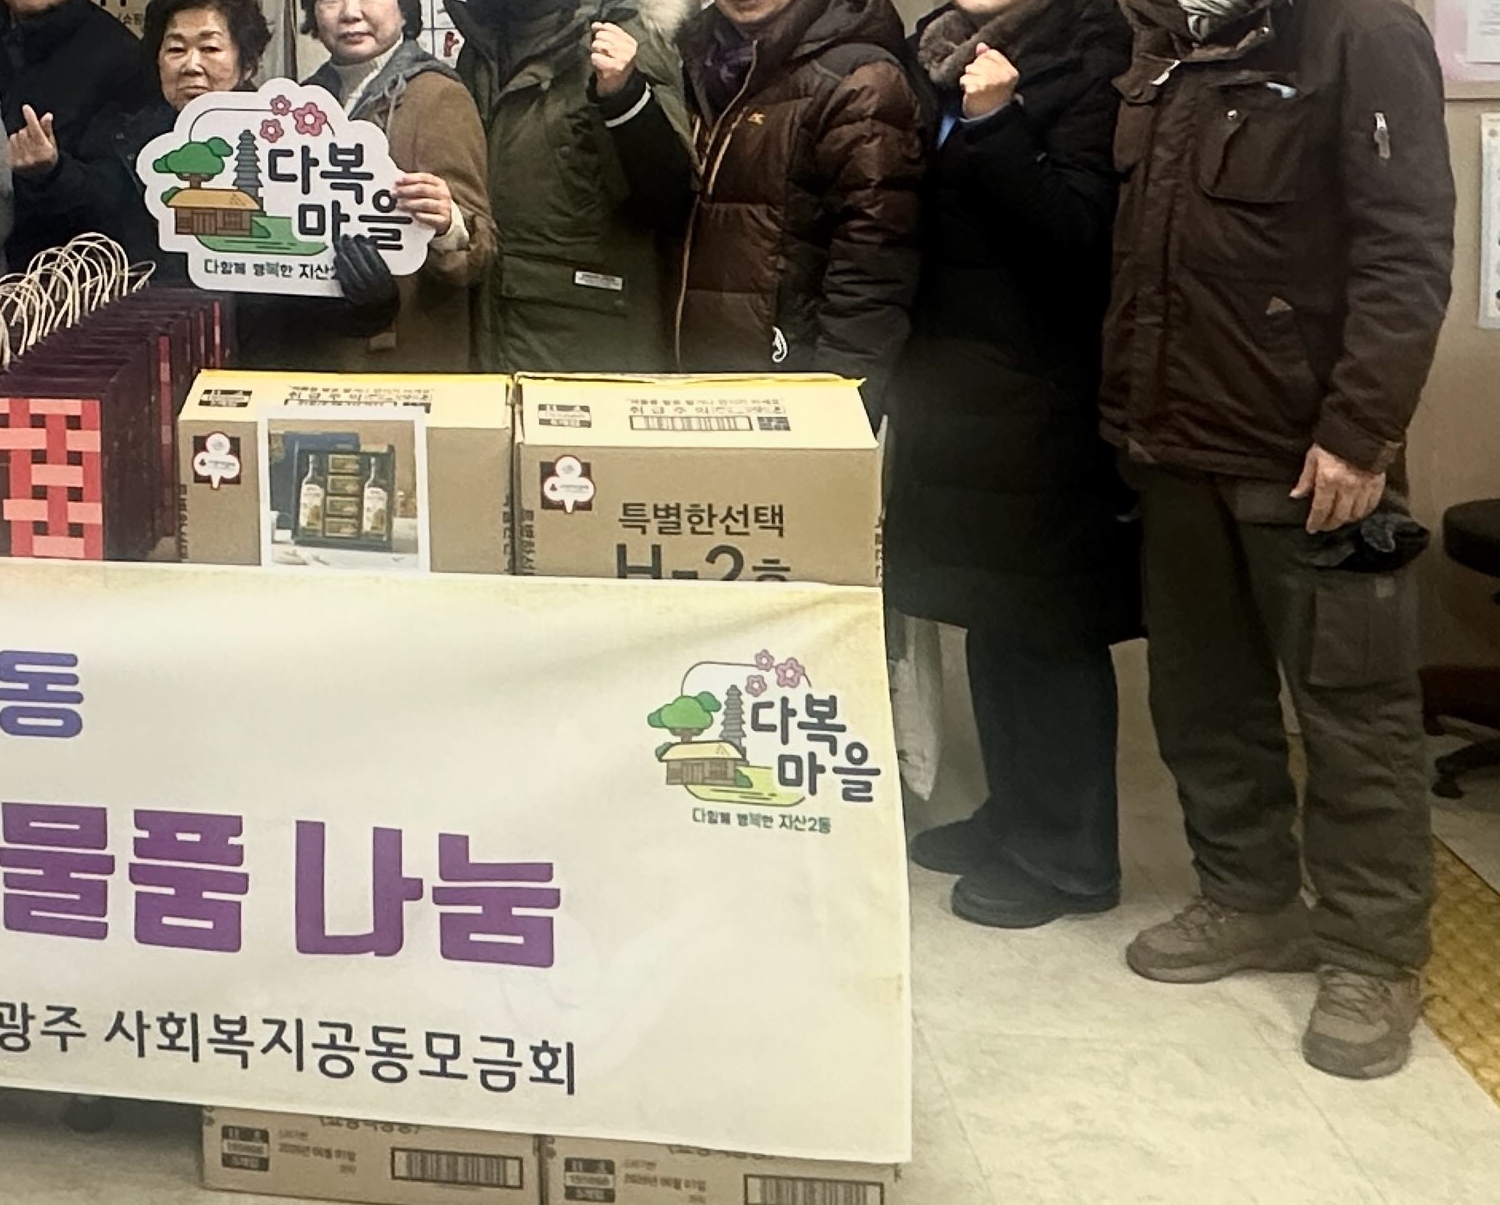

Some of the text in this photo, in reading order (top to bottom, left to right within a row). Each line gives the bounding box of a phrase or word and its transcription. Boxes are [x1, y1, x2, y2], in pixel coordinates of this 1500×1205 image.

[268, 142, 374, 205] 다복
[298, 188, 414, 251] 마을
[618, 501, 785, 539] 특별한선택
[750, 693, 847, 757] 다복
[777, 741, 881, 803] 마을
[736, 811, 775, 830] 행복한
[778, 813, 833, 835] 지산2동
[294, 820, 562, 969] 나눔
[104, 1008, 577, 1096] 사회복지공동모금회
